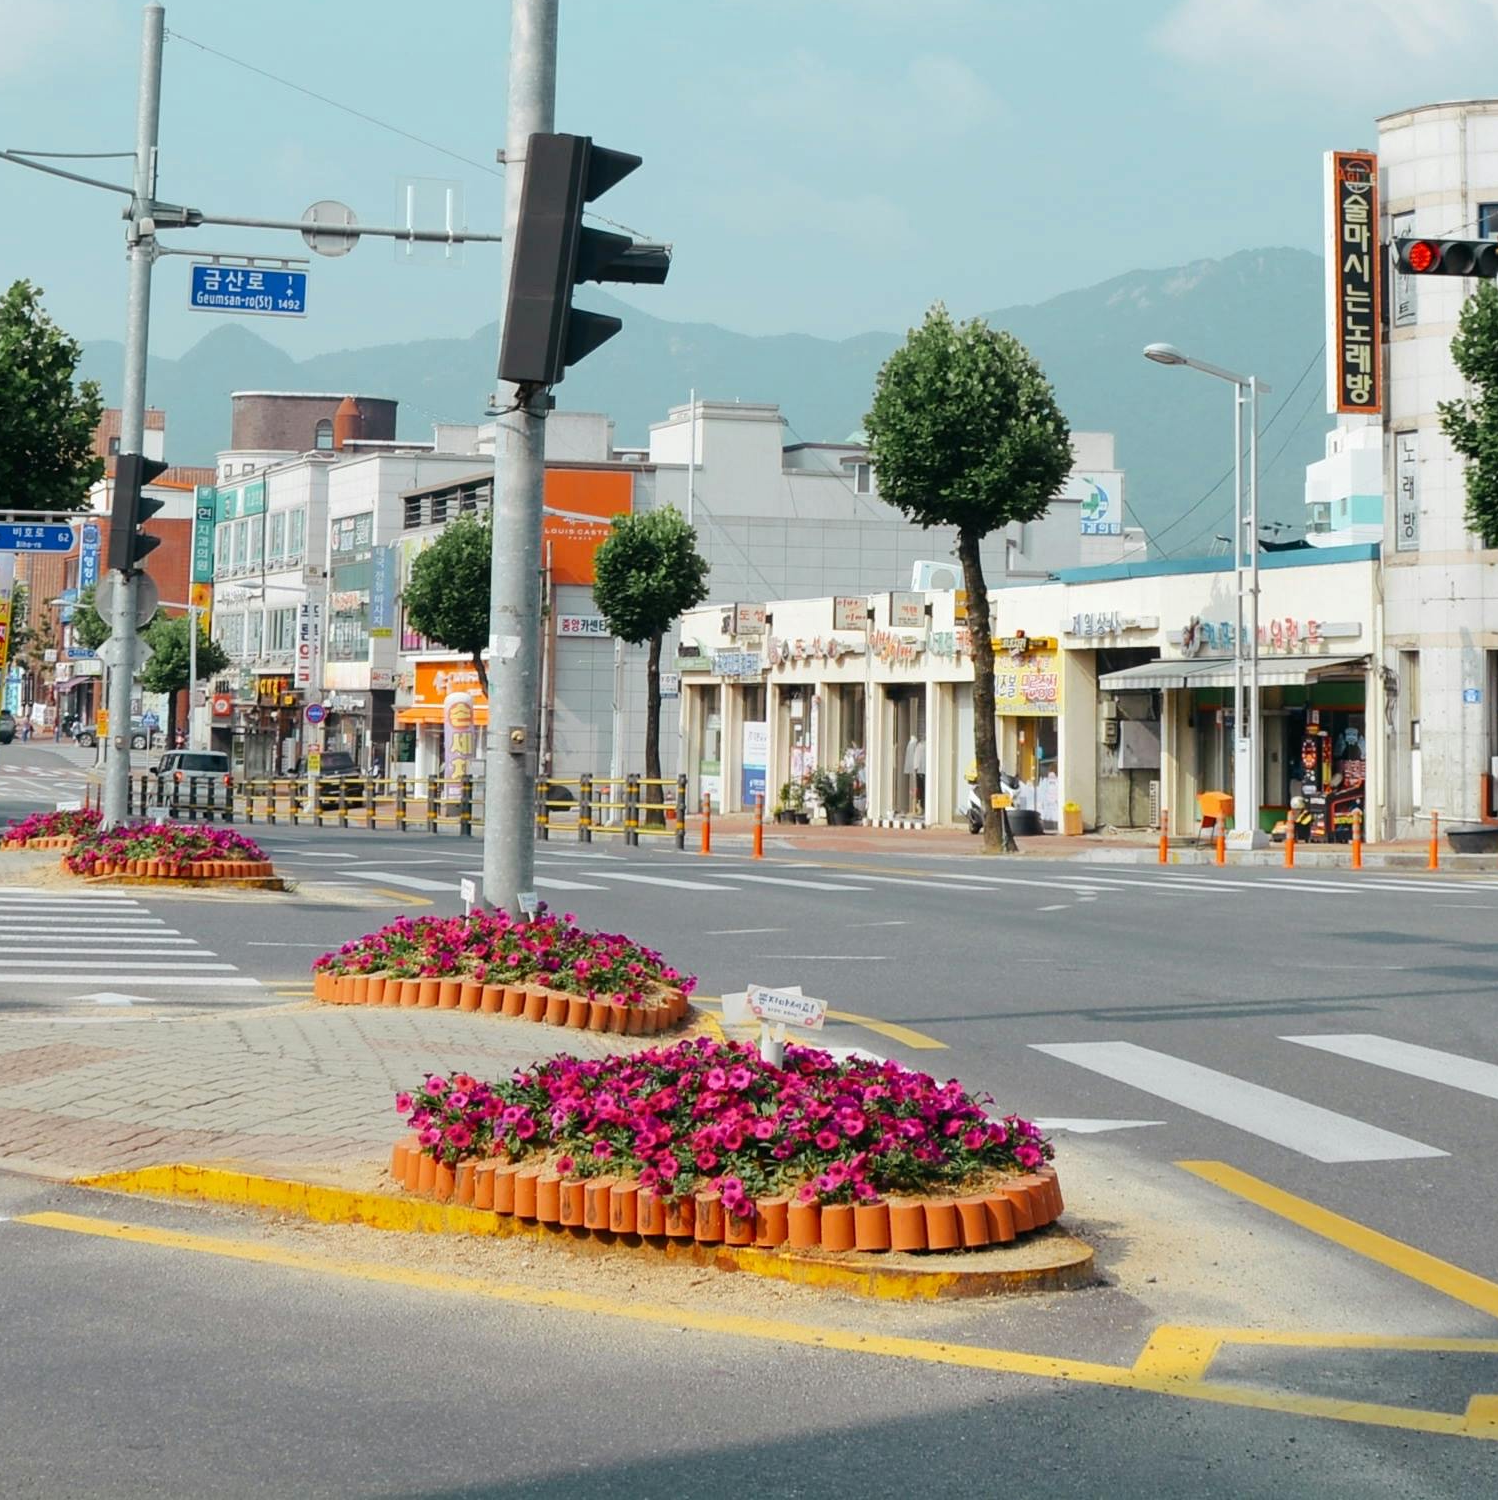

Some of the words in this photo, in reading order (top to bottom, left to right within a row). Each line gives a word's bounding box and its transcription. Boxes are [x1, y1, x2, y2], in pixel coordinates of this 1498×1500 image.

[203, 269, 265, 292] 금산로
[196, 291, 273, 310] Geumsan-ro(St)
[278, 299, 300, 310] 1492
[1343, 194, 1374, 405] 술마시는노래방
[1402, 441, 1416, 538] 노래방
[12, 527, 45, 538] 비호로
[57, 533, 70, 542] 62
